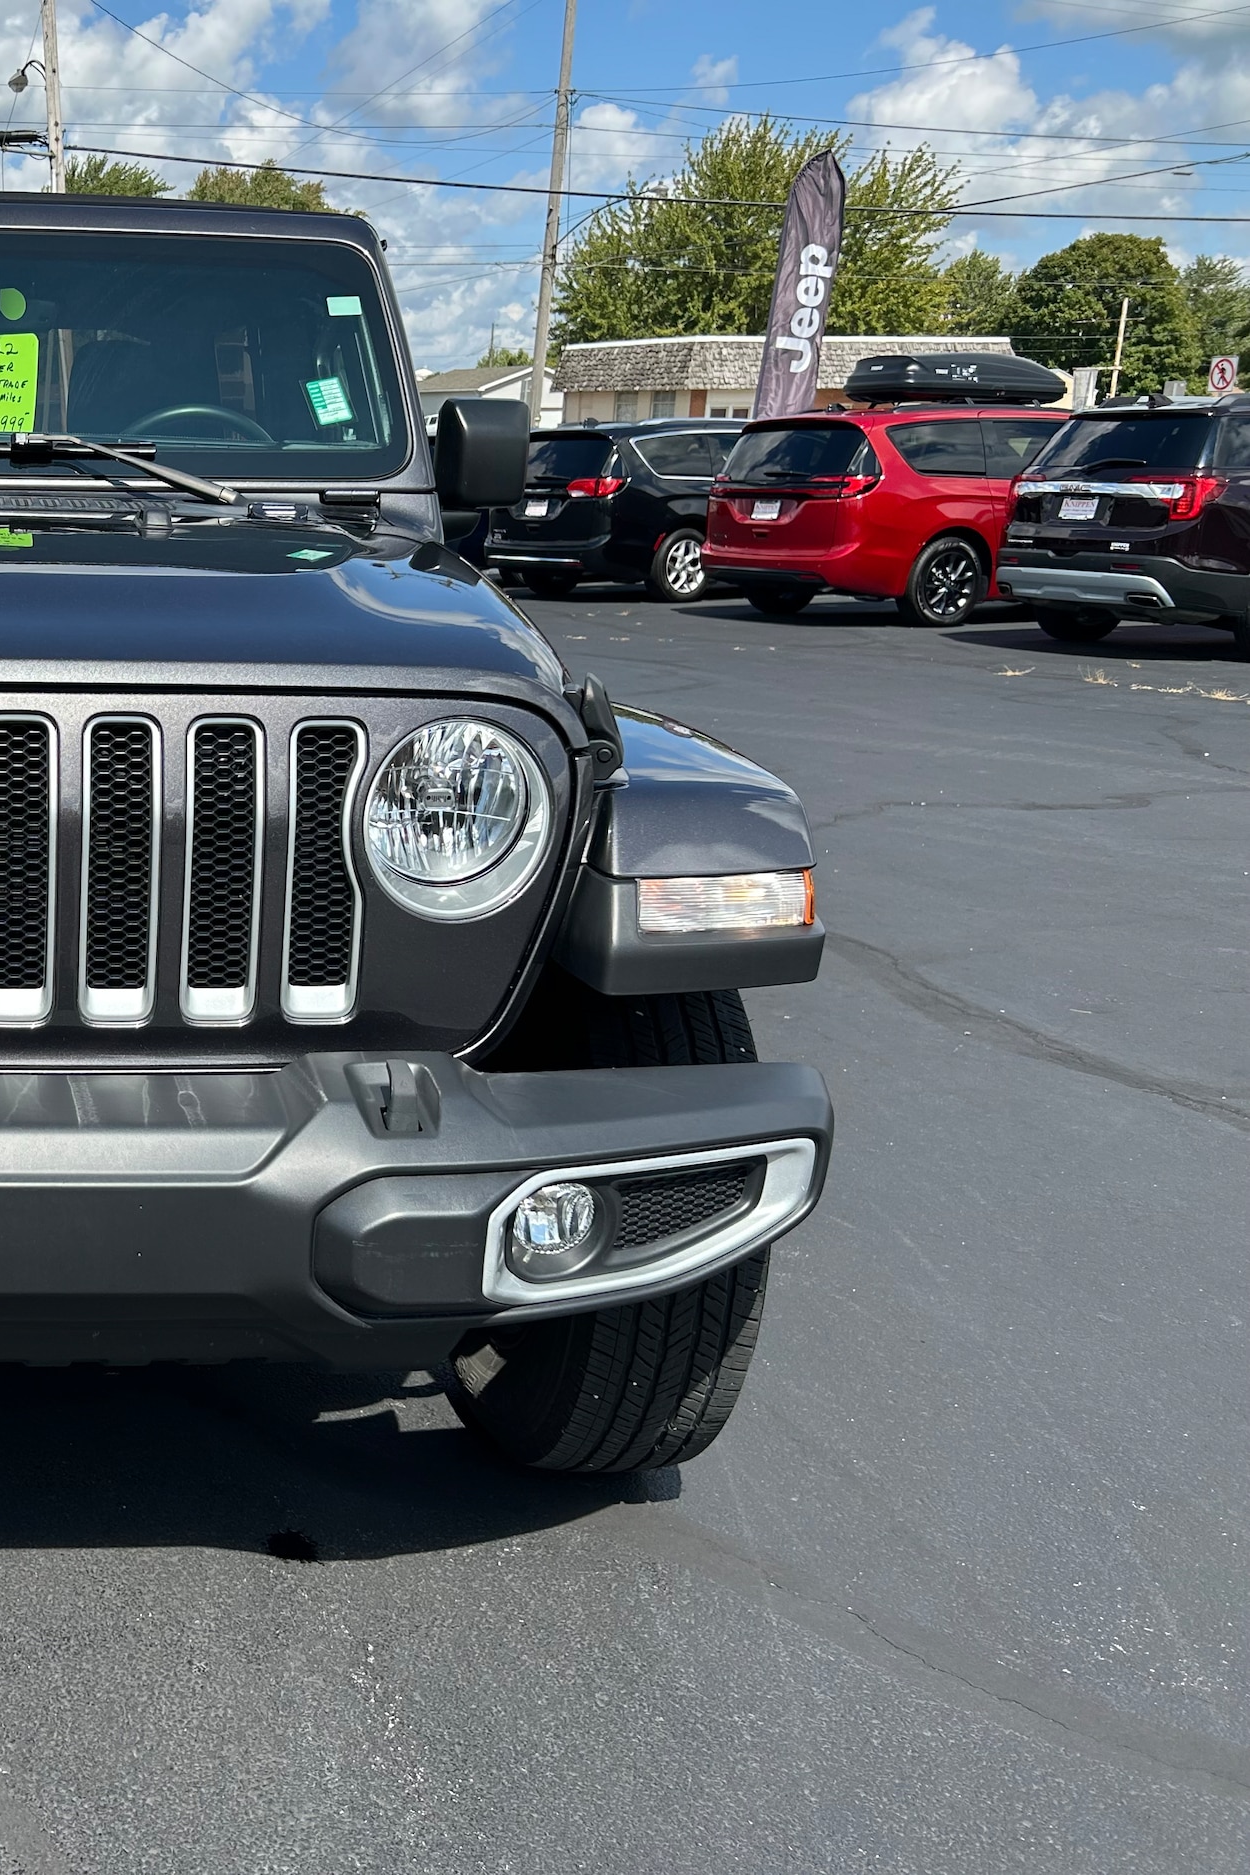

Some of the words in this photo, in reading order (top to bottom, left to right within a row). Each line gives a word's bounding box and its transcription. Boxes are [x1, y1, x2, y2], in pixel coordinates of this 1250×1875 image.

[775, 243, 833, 373] Jeep
[1060, 484, 1092, 492] GMC
[1064, 500, 1096, 508] KNIPPEN
